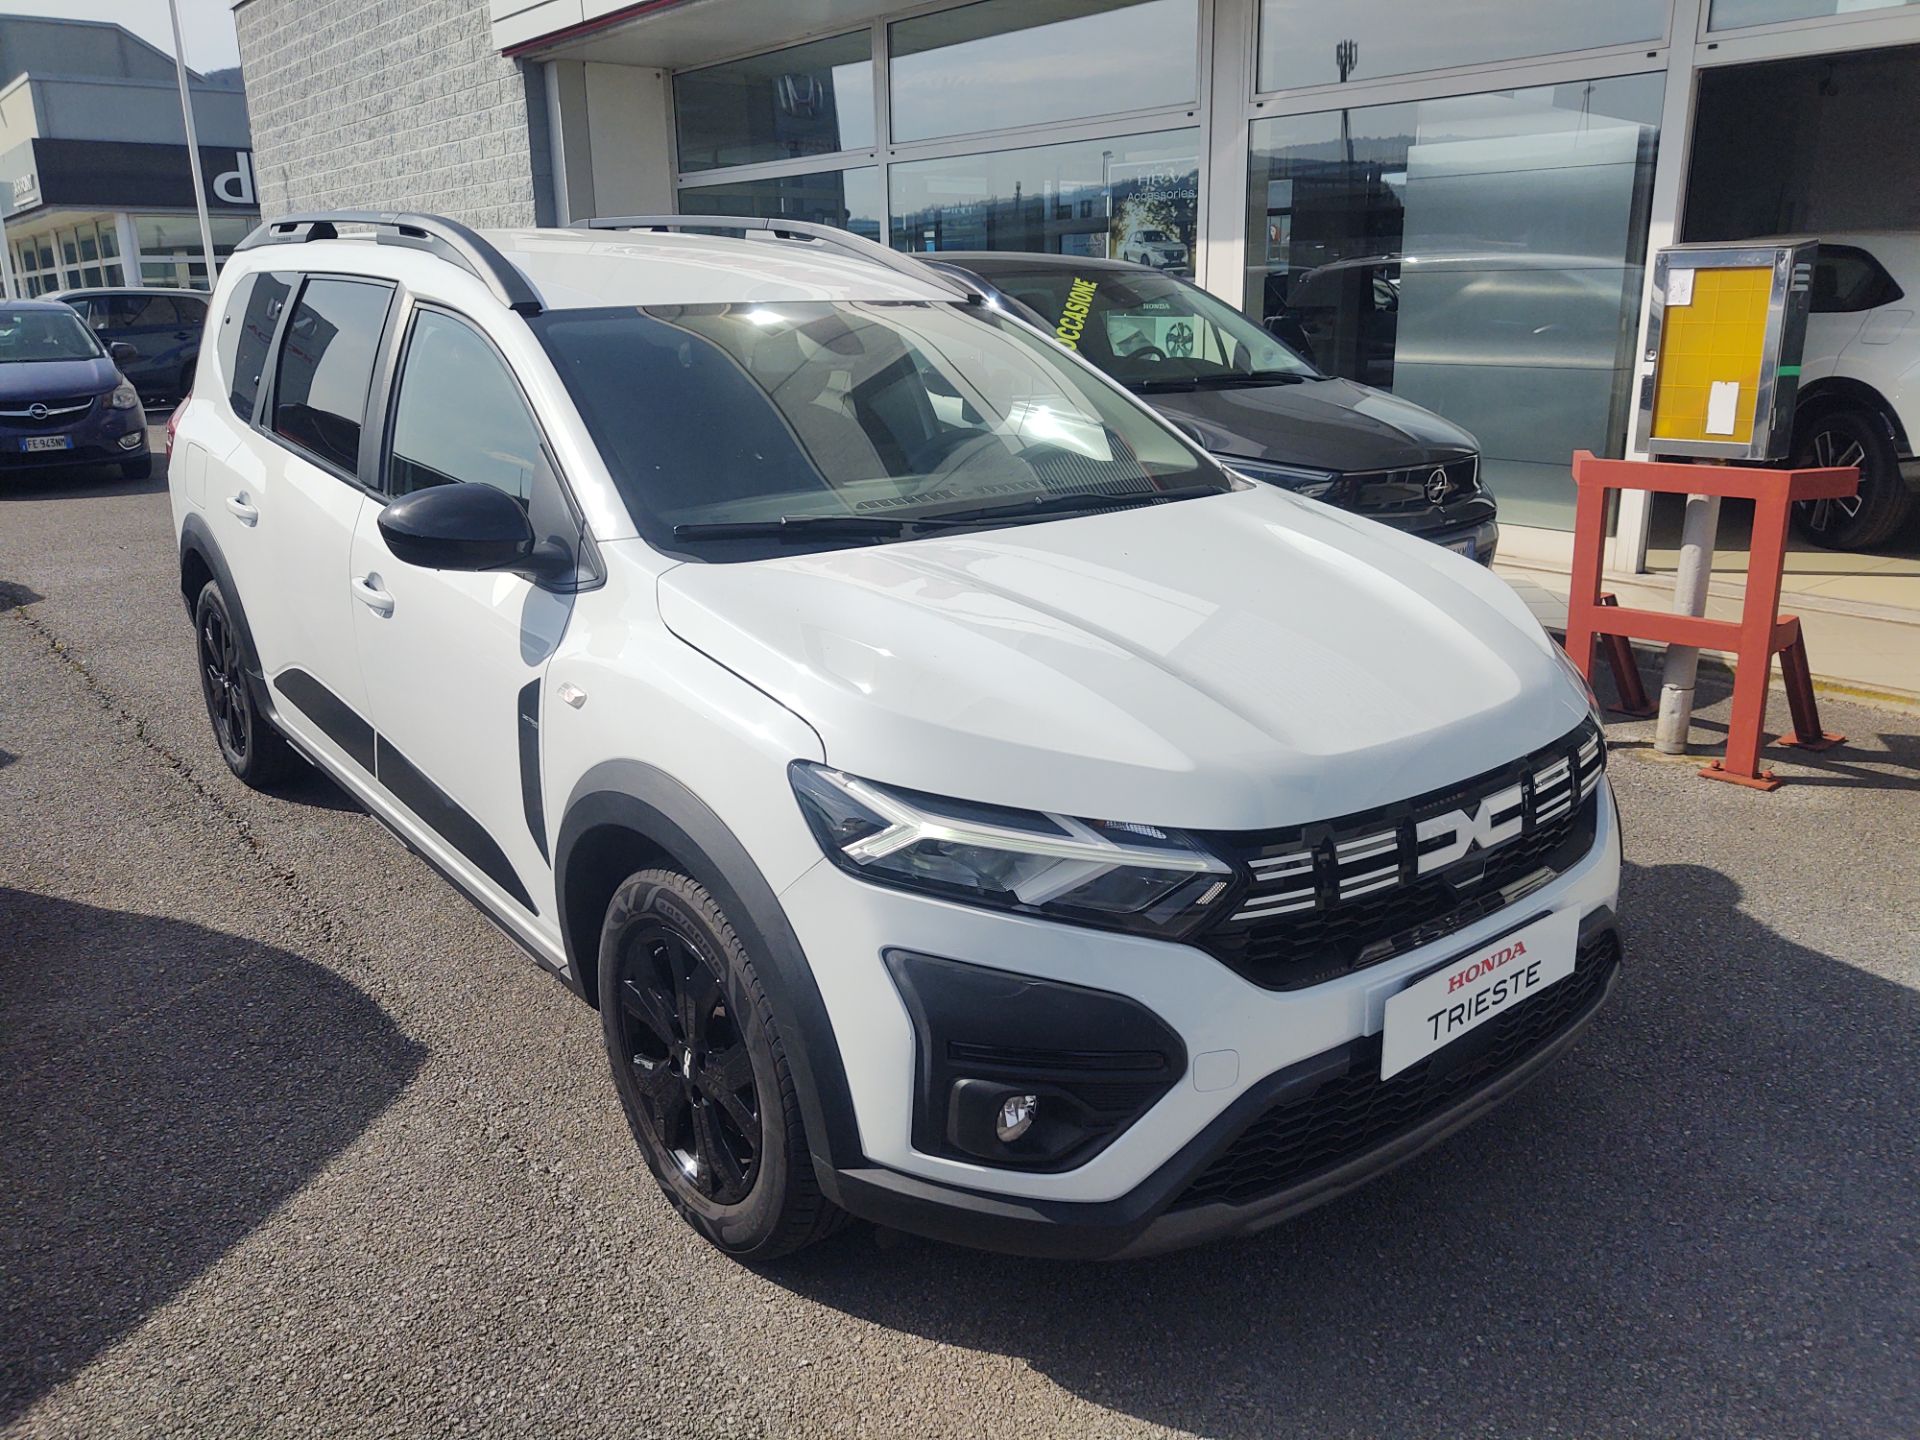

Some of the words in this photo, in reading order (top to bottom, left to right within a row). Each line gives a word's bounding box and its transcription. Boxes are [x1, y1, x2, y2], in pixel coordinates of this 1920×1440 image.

[1127, 188, 1195, 201] Accessories
[1056, 277, 1098, 351] OCCASIONE
[1143, 302, 1171, 311] HONDA
[1448, 941, 1527, 994] HONDA
[1427, 960, 1542, 1041] TRIESTE
